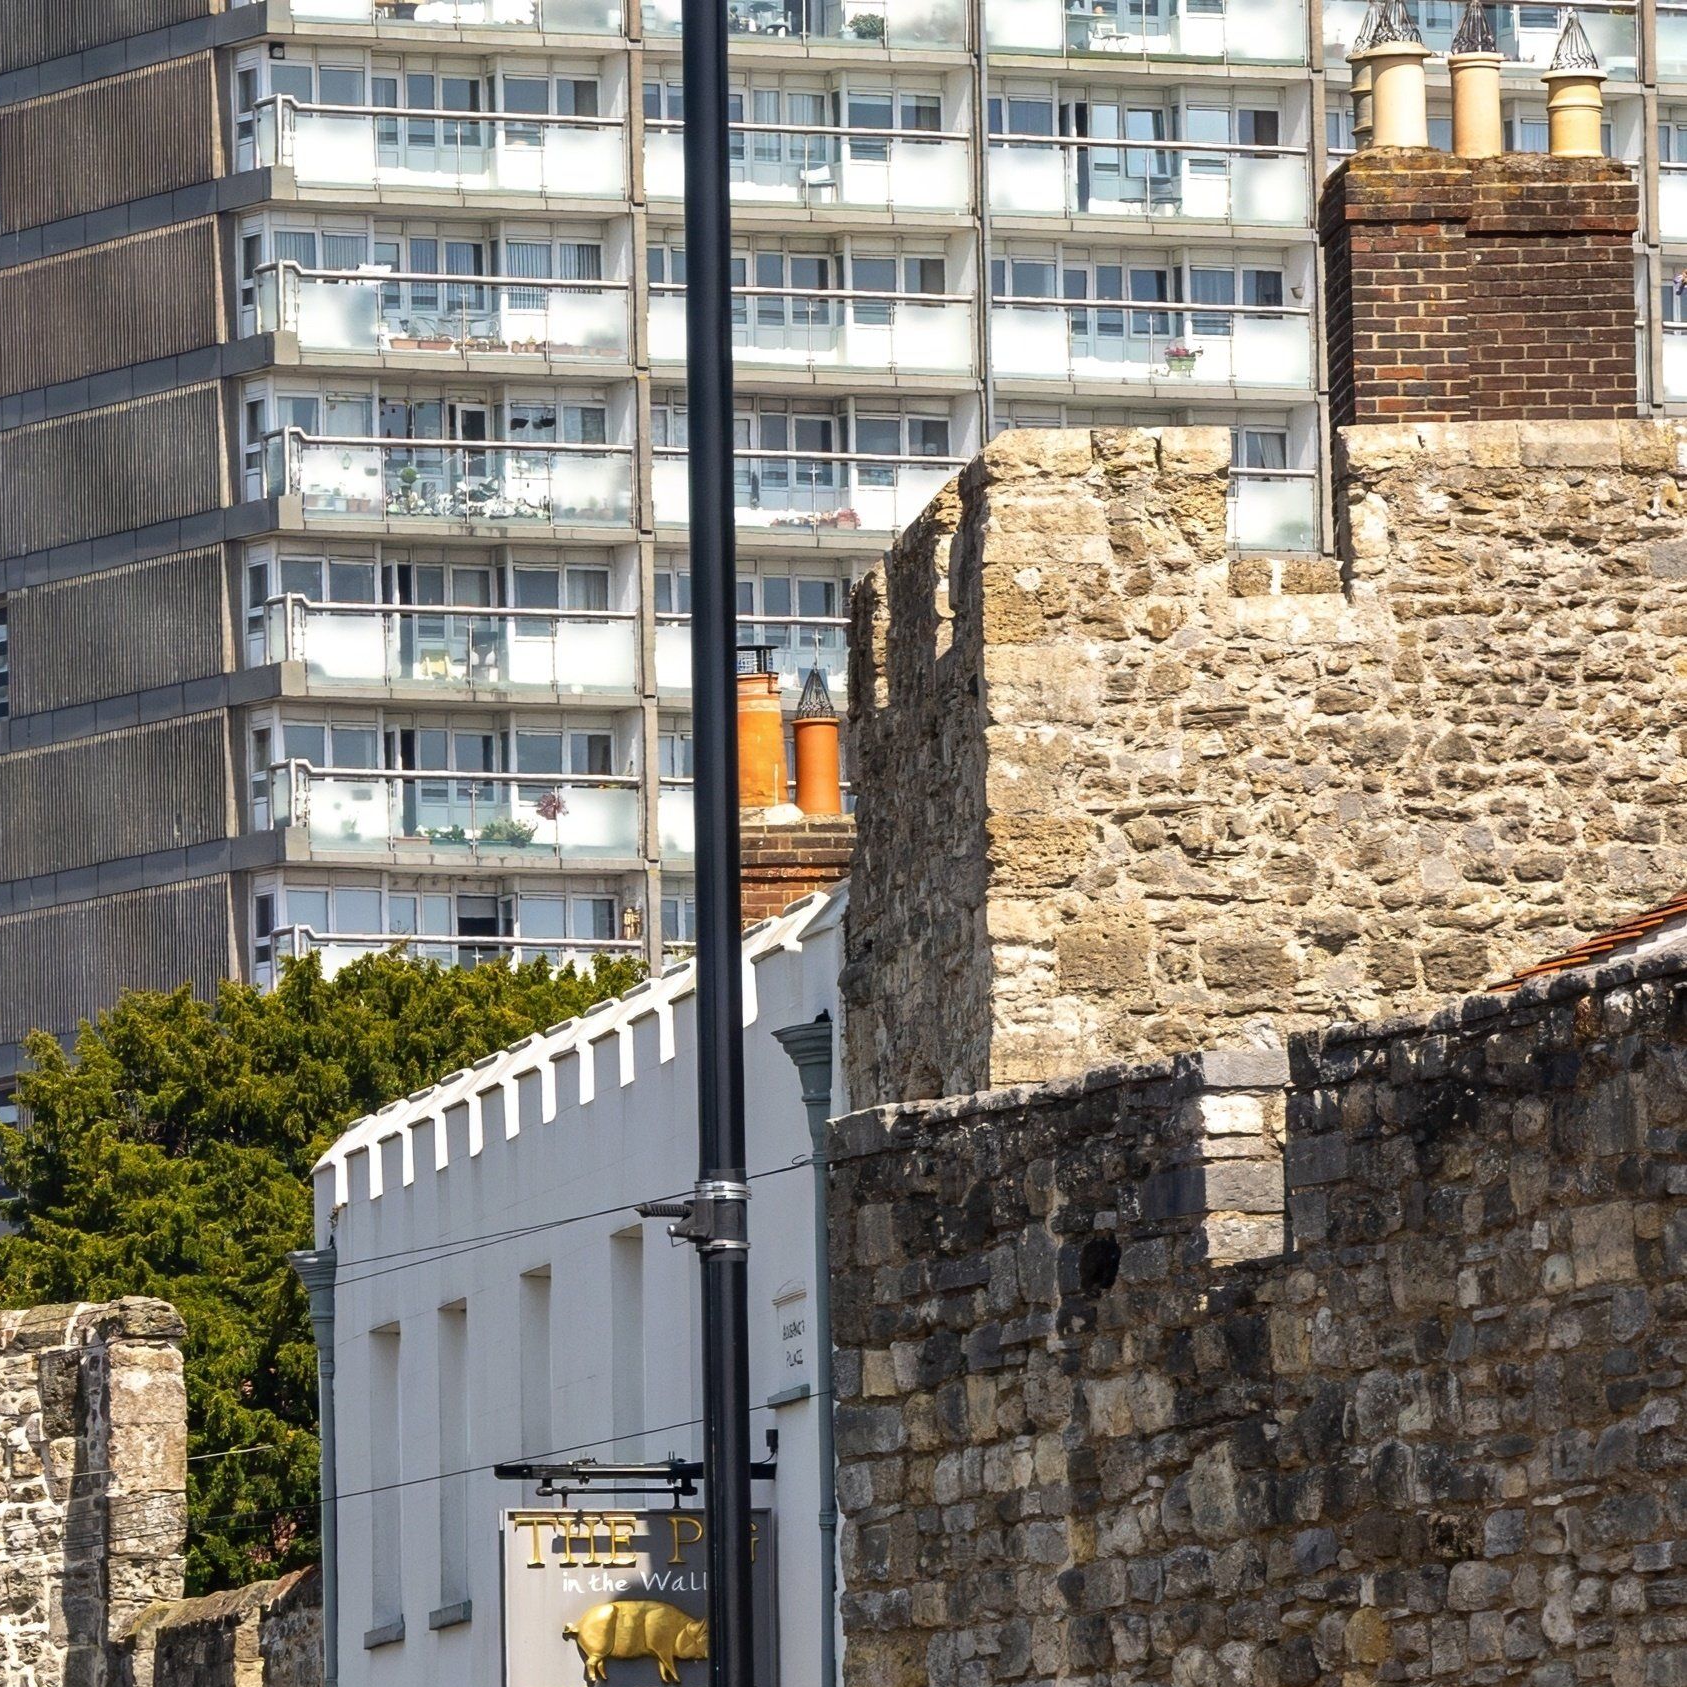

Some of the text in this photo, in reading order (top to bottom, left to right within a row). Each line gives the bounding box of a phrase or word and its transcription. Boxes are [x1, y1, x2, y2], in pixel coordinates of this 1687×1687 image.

[514, 1515, 637, 1568] THE
[562, 1570, 708, 1593] in the Wall
